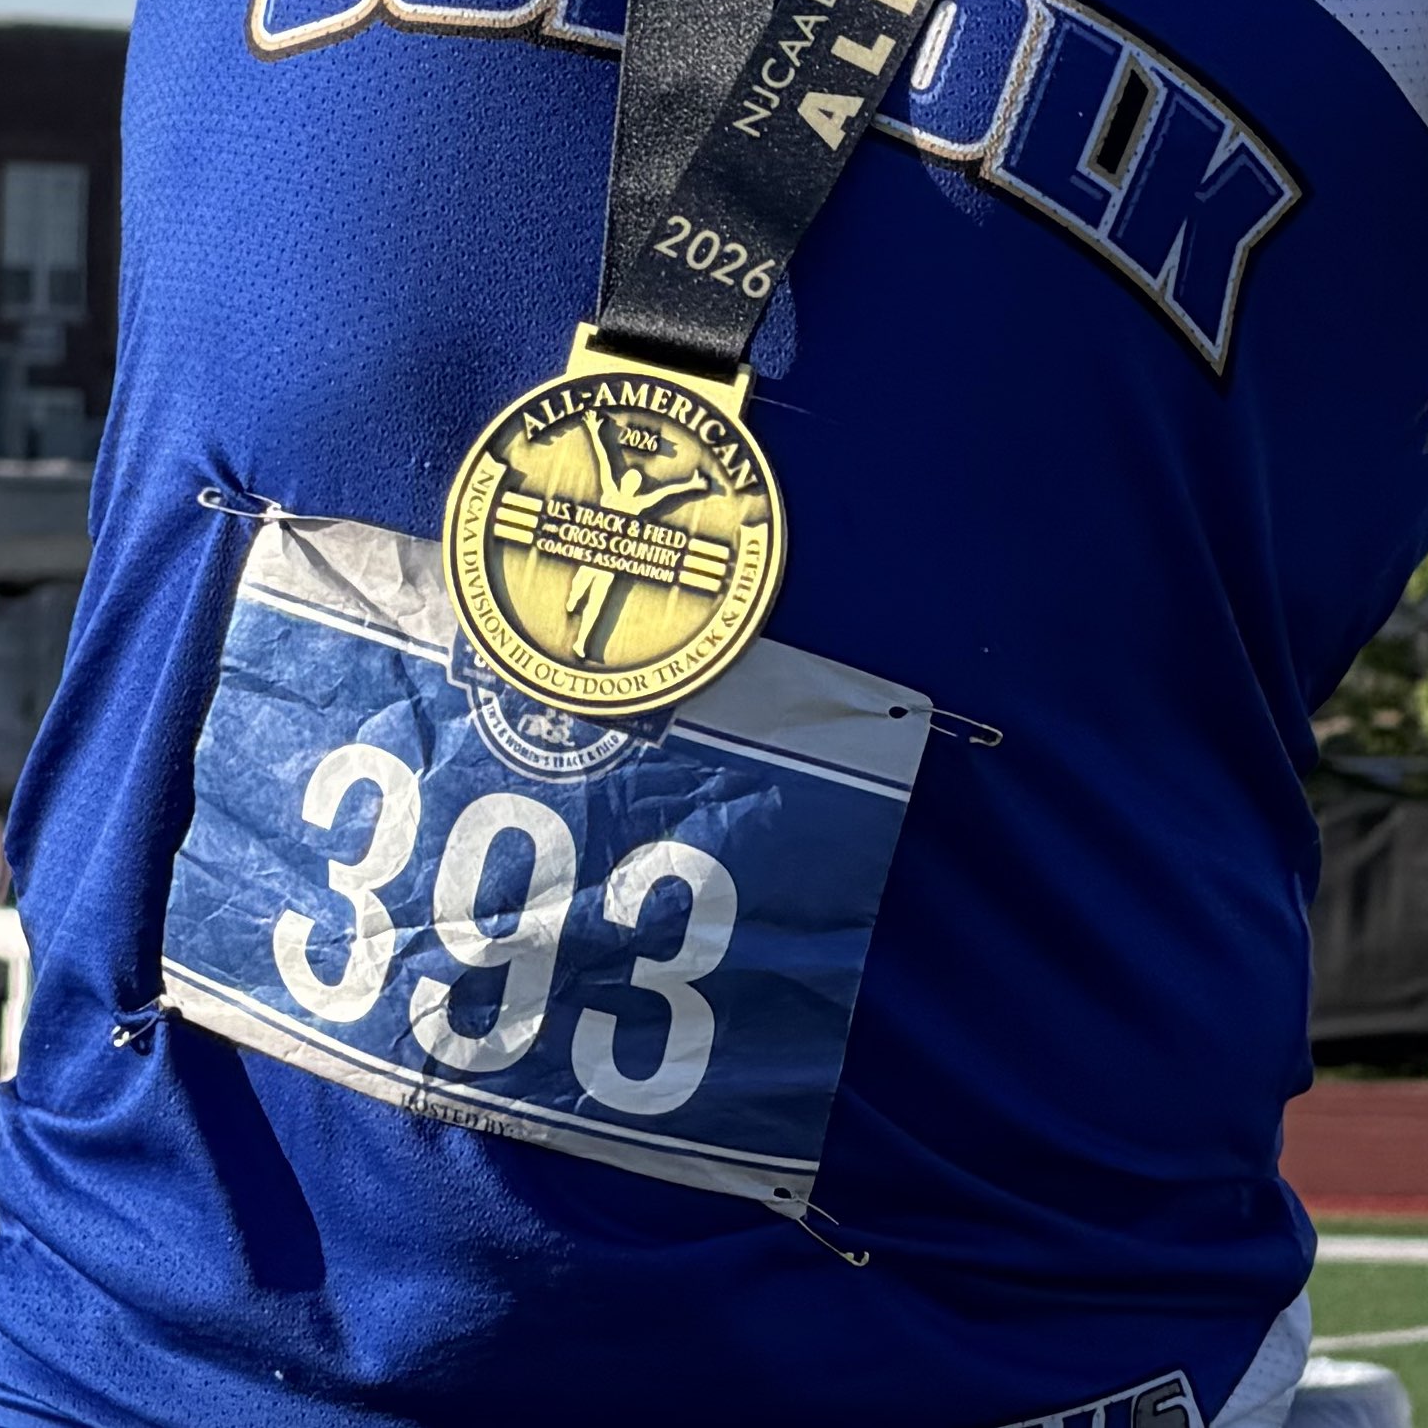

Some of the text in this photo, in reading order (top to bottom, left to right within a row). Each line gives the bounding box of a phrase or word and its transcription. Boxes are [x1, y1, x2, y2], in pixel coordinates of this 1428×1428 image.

[733, 15, 828, 138] NJCAA
[653, 214, 773, 301] 2026
[522, 380, 759, 491] ALL-AMERICAN
[619, 426, 659, 453] 2026
[463, 469, 495, 543] NJCAA
[575, 504, 626, 534] TRACK
[627, 520, 641, 538] &
[643, 523, 687, 549] FIELD
[558, 523, 608, 550] CROSS
[609, 536, 682, 568] COUNTRY
[593, 552, 675, 583] ASSOCIATION
[732, 539, 761, 605] FIELD
[463, 550, 513, 649] DIVISION
[721, 610, 740, 628] &
[508, 644, 535, 670] III
[534, 662, 649, 697] OUTDOOR
[652, 629, 726, 685] TRACK
[271, 743, 740, 1116] 393
